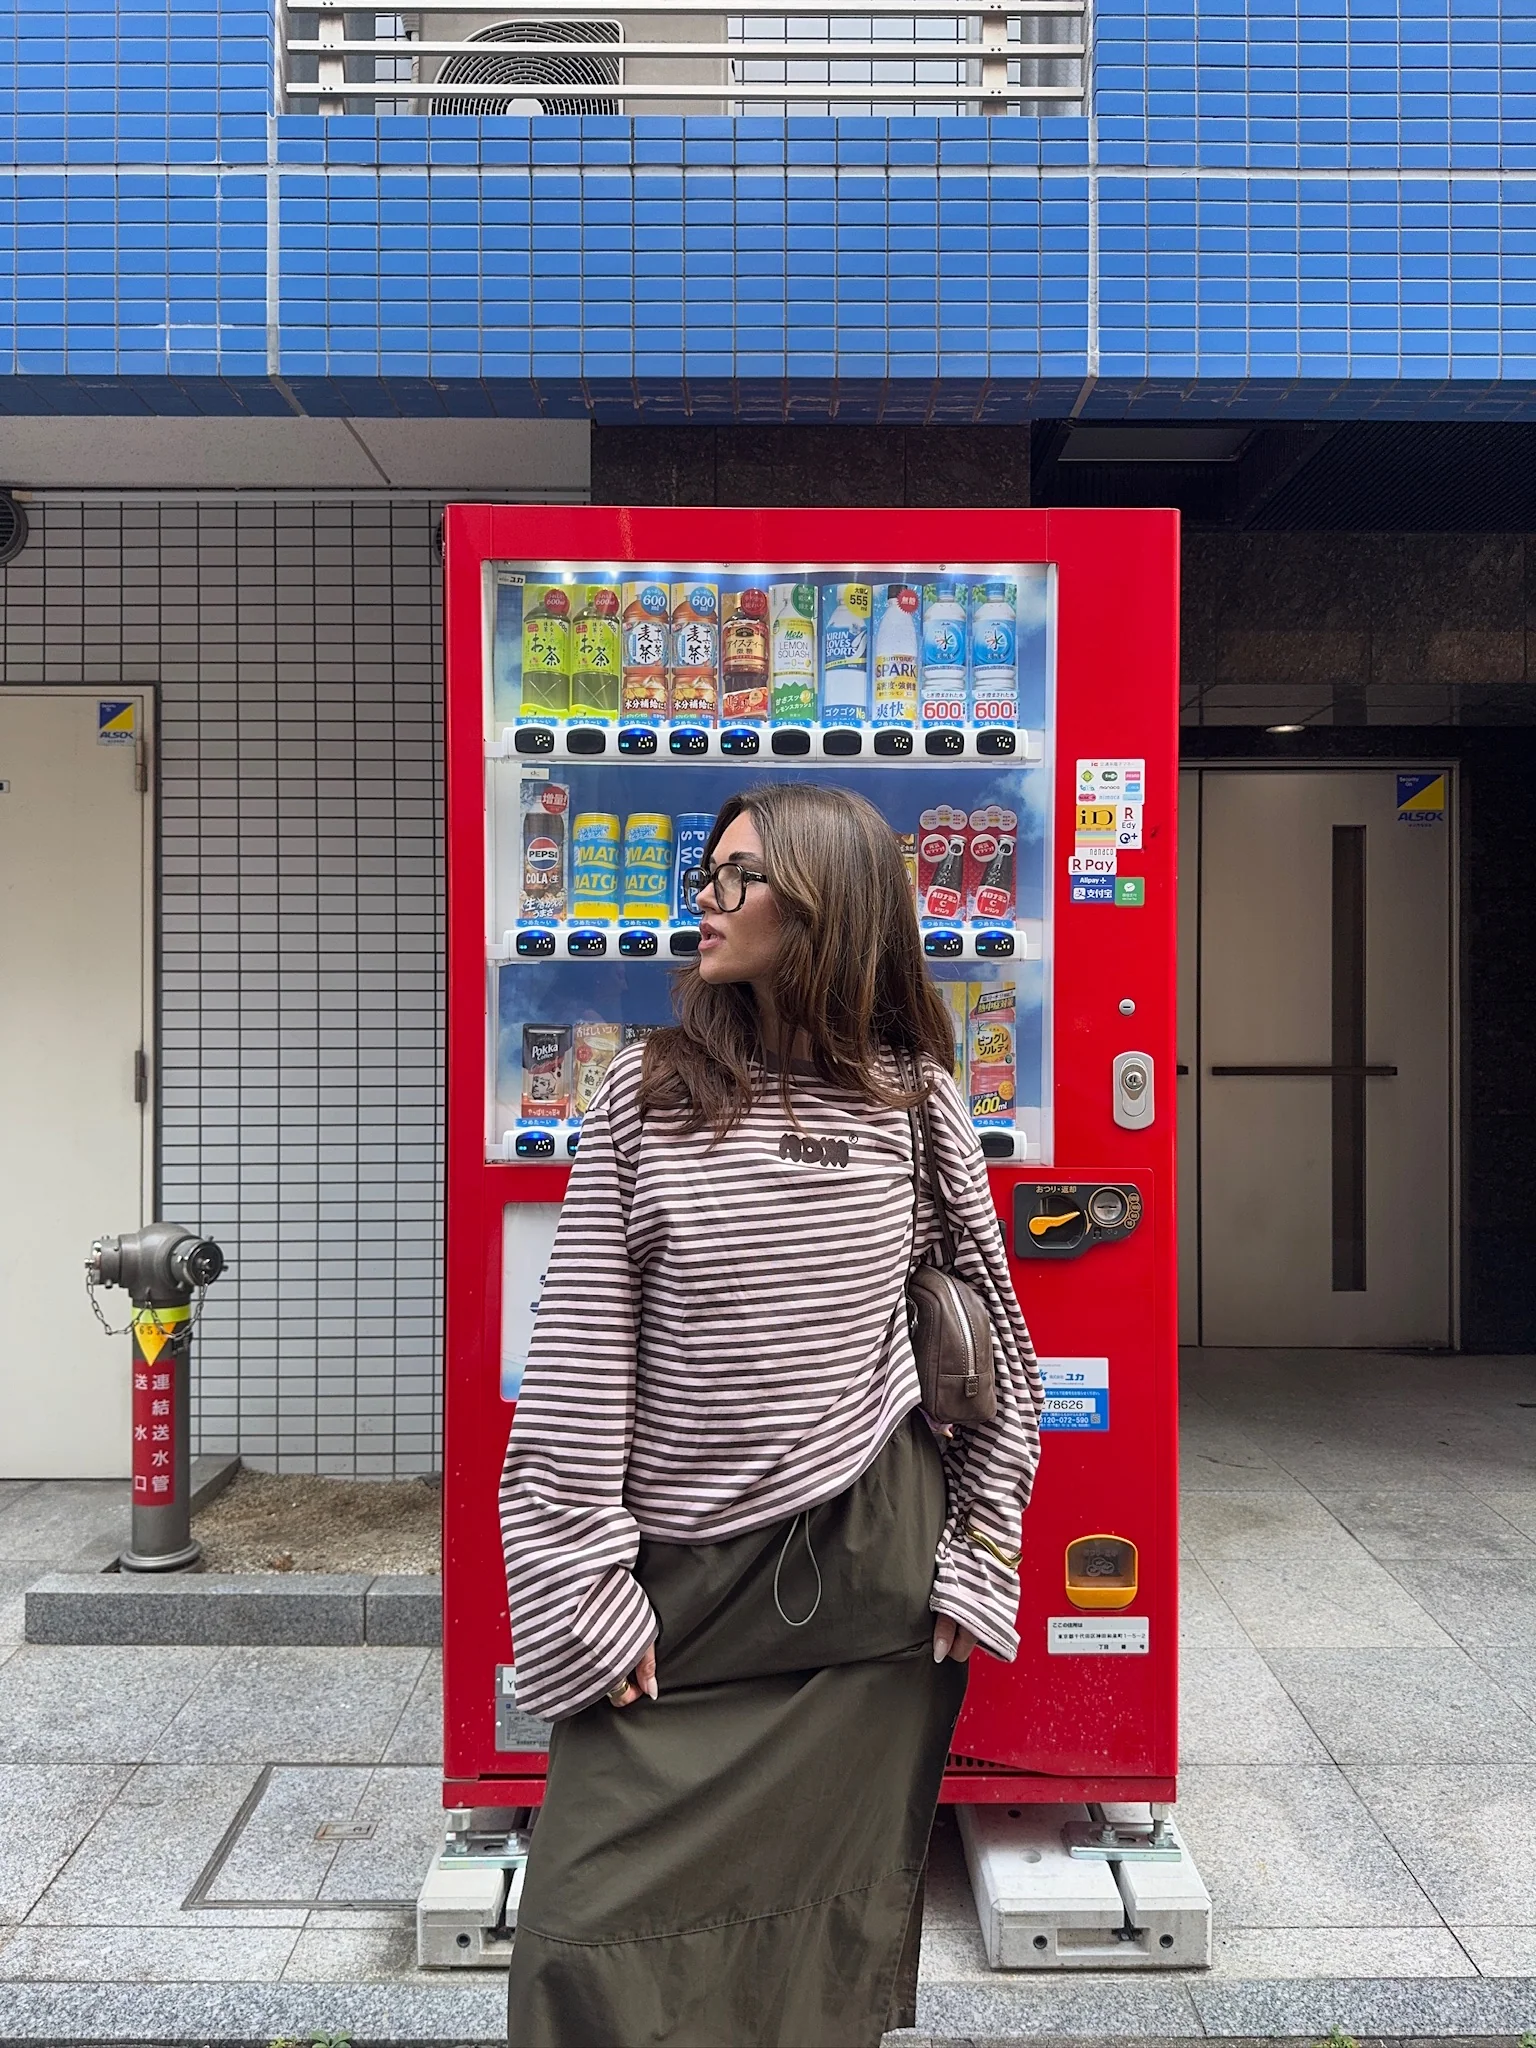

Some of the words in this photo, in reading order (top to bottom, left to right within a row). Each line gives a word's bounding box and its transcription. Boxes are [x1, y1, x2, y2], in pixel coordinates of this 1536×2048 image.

[643, 595, 665, 606] 600
[692, 595, 714, 607] 600
[849, 594, 868, 606] 555
[826, 631, 849, 641] KIRIN
[638, 625, 655, 662] 麦茶
[687, 625, 704, 663] 麦茶
[727, 640, 764, 648] アイスティー
[780, 641, 808, 650] LEMON
[826, 639, 851, 649] LOVES
[778, 650, 810, 658] SQUASH
[826, 648, 857, 657] SPORTS
[876, 663, 917, 678] SPARK
[625, 699, 667, 710] 水分補給に!
[674, 699, 715, 710] 水分補給に!
[877, 701, 904, 718] 爽快
[924, 702, 961, 718] 600
[975, 702, 1012, 718] 600
[100, 731, 134, 739] ALSOK
[543, 793, 568, 806] 増量!
[1080, 810, 1113, 825] iD
[1125, 807, 1134, 819] R
[1397, 812, 1443, 821] ALSOK
[1089, 848, 1114, 856] nanaco
[1072, 859, 1082, 871] R
[1085, 859, 1114, 872] Pay
[526, 874, 548, 884] COLA
[932, 891, 957, 903] オロナミン
[981, 891, 1007, 903] オロナミン
[1086, 889, 1113, 898] 支付宝
[576, 1026, 619, 1038] 香ばしいコク
[978, 1033, 1009, 1046] ピングレ
[531, 1043, 559, 1059] Pokka
[979, 1044, 1009, 1056] ソルティ
[973, 1096, 1008, 1116] 600ml
[1035, 1185, 1077, 1194] おつり・返却
[1065, 1373, 1085, 1381] ユカ
[134, 1373, 148, 1492] 送水口
[151, 1374, 170, 1493] 連結送水管
